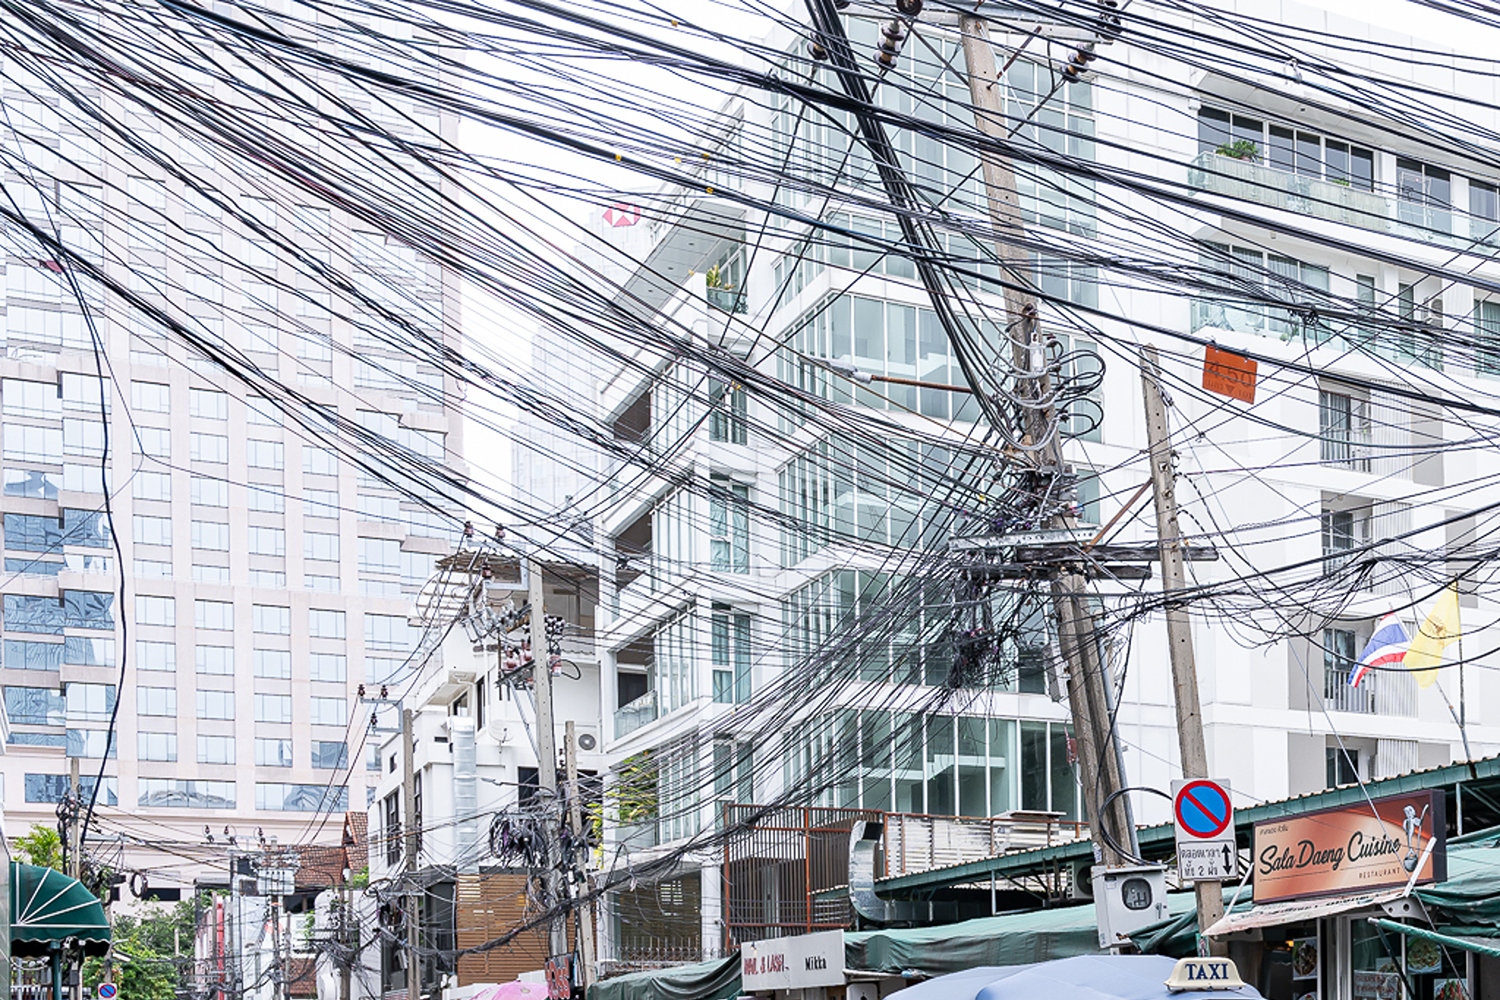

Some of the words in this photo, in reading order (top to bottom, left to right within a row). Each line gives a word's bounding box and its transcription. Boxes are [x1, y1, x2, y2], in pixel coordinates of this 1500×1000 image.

[1259, 844, 1297, 876] Sala
[1295, 840, 1345, 871] Daeng
[1347, 831, 1402, 862] Cuisine
[1198, 866, 1205, 877] 2
[1358, 867, 1401, 880] RESTAURANT
[804, 955, 827, 971] Mikka
[1184, 962, 1229, 981] TAXI
